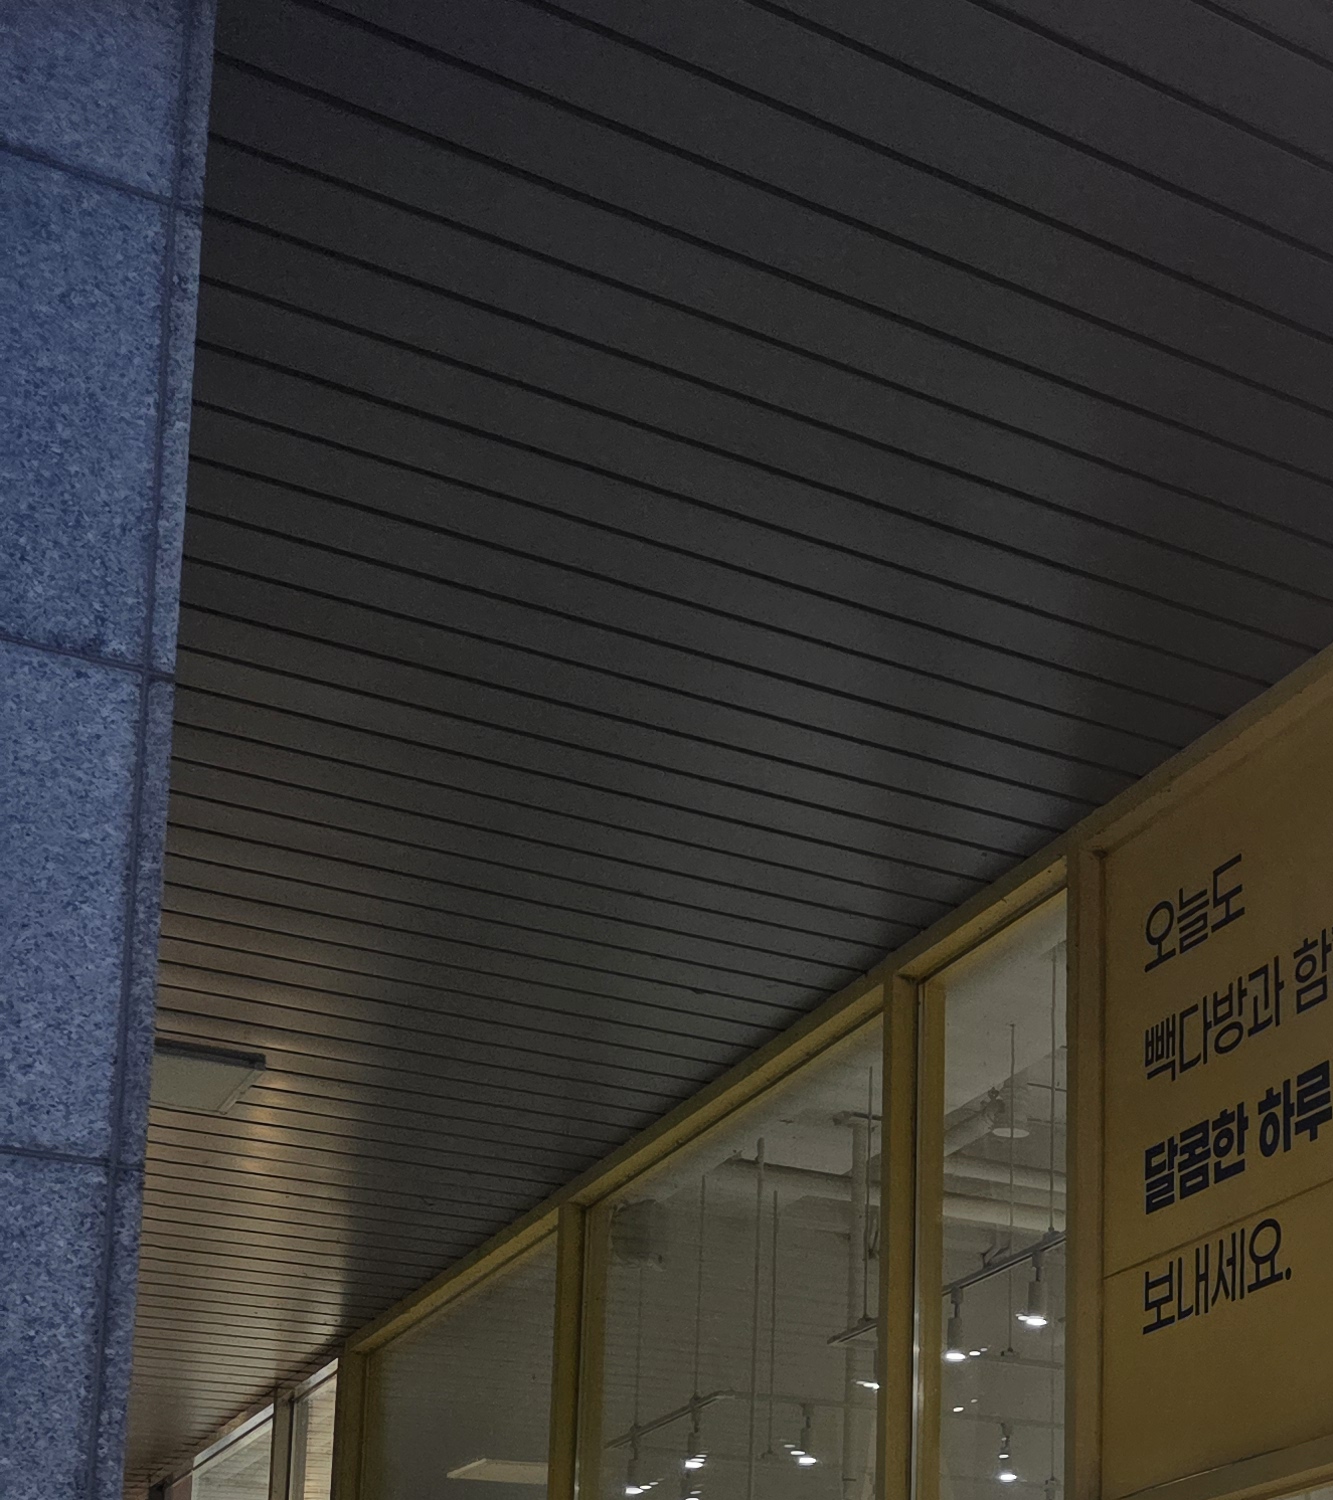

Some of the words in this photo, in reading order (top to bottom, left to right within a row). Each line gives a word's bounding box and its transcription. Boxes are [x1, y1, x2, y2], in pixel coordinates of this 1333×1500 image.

[1144, 854, 1245, 973] 오늘도
[1144, 962, 1286, 1082] 빽다방과
[1143, 1108, 1251, 1215] 달콤한
[1257, 1060, 1333, 1160] 하루
[1142, 1218, 1293, 1336] 보내세요.
